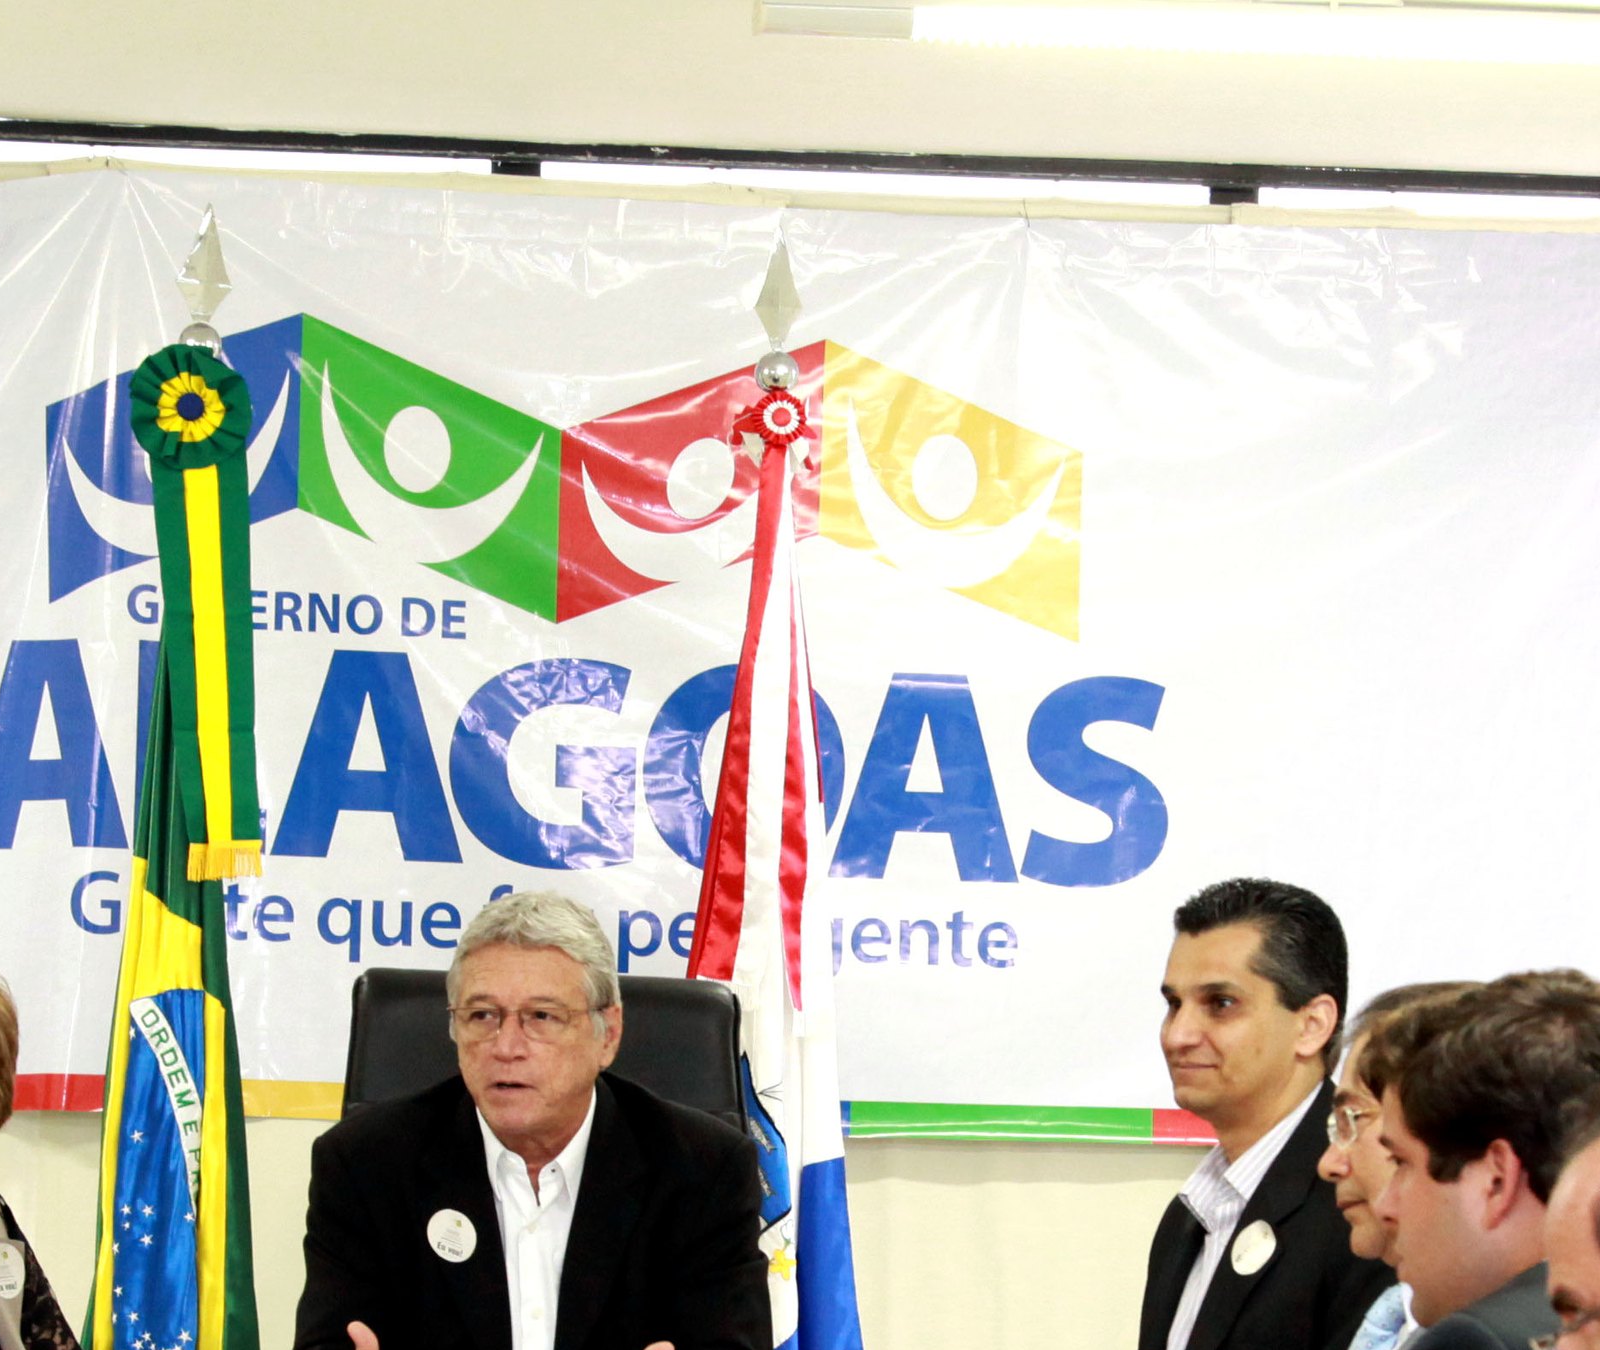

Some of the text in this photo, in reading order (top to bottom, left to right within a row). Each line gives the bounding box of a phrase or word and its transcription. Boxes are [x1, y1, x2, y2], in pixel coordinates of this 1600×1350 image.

[126, 583, 467, 640] GERNO DE
[69, 870, 295, 943] Gte
[317, 897, 462, 963] que
[140, 1007, 200, 1137] ORDEM E
